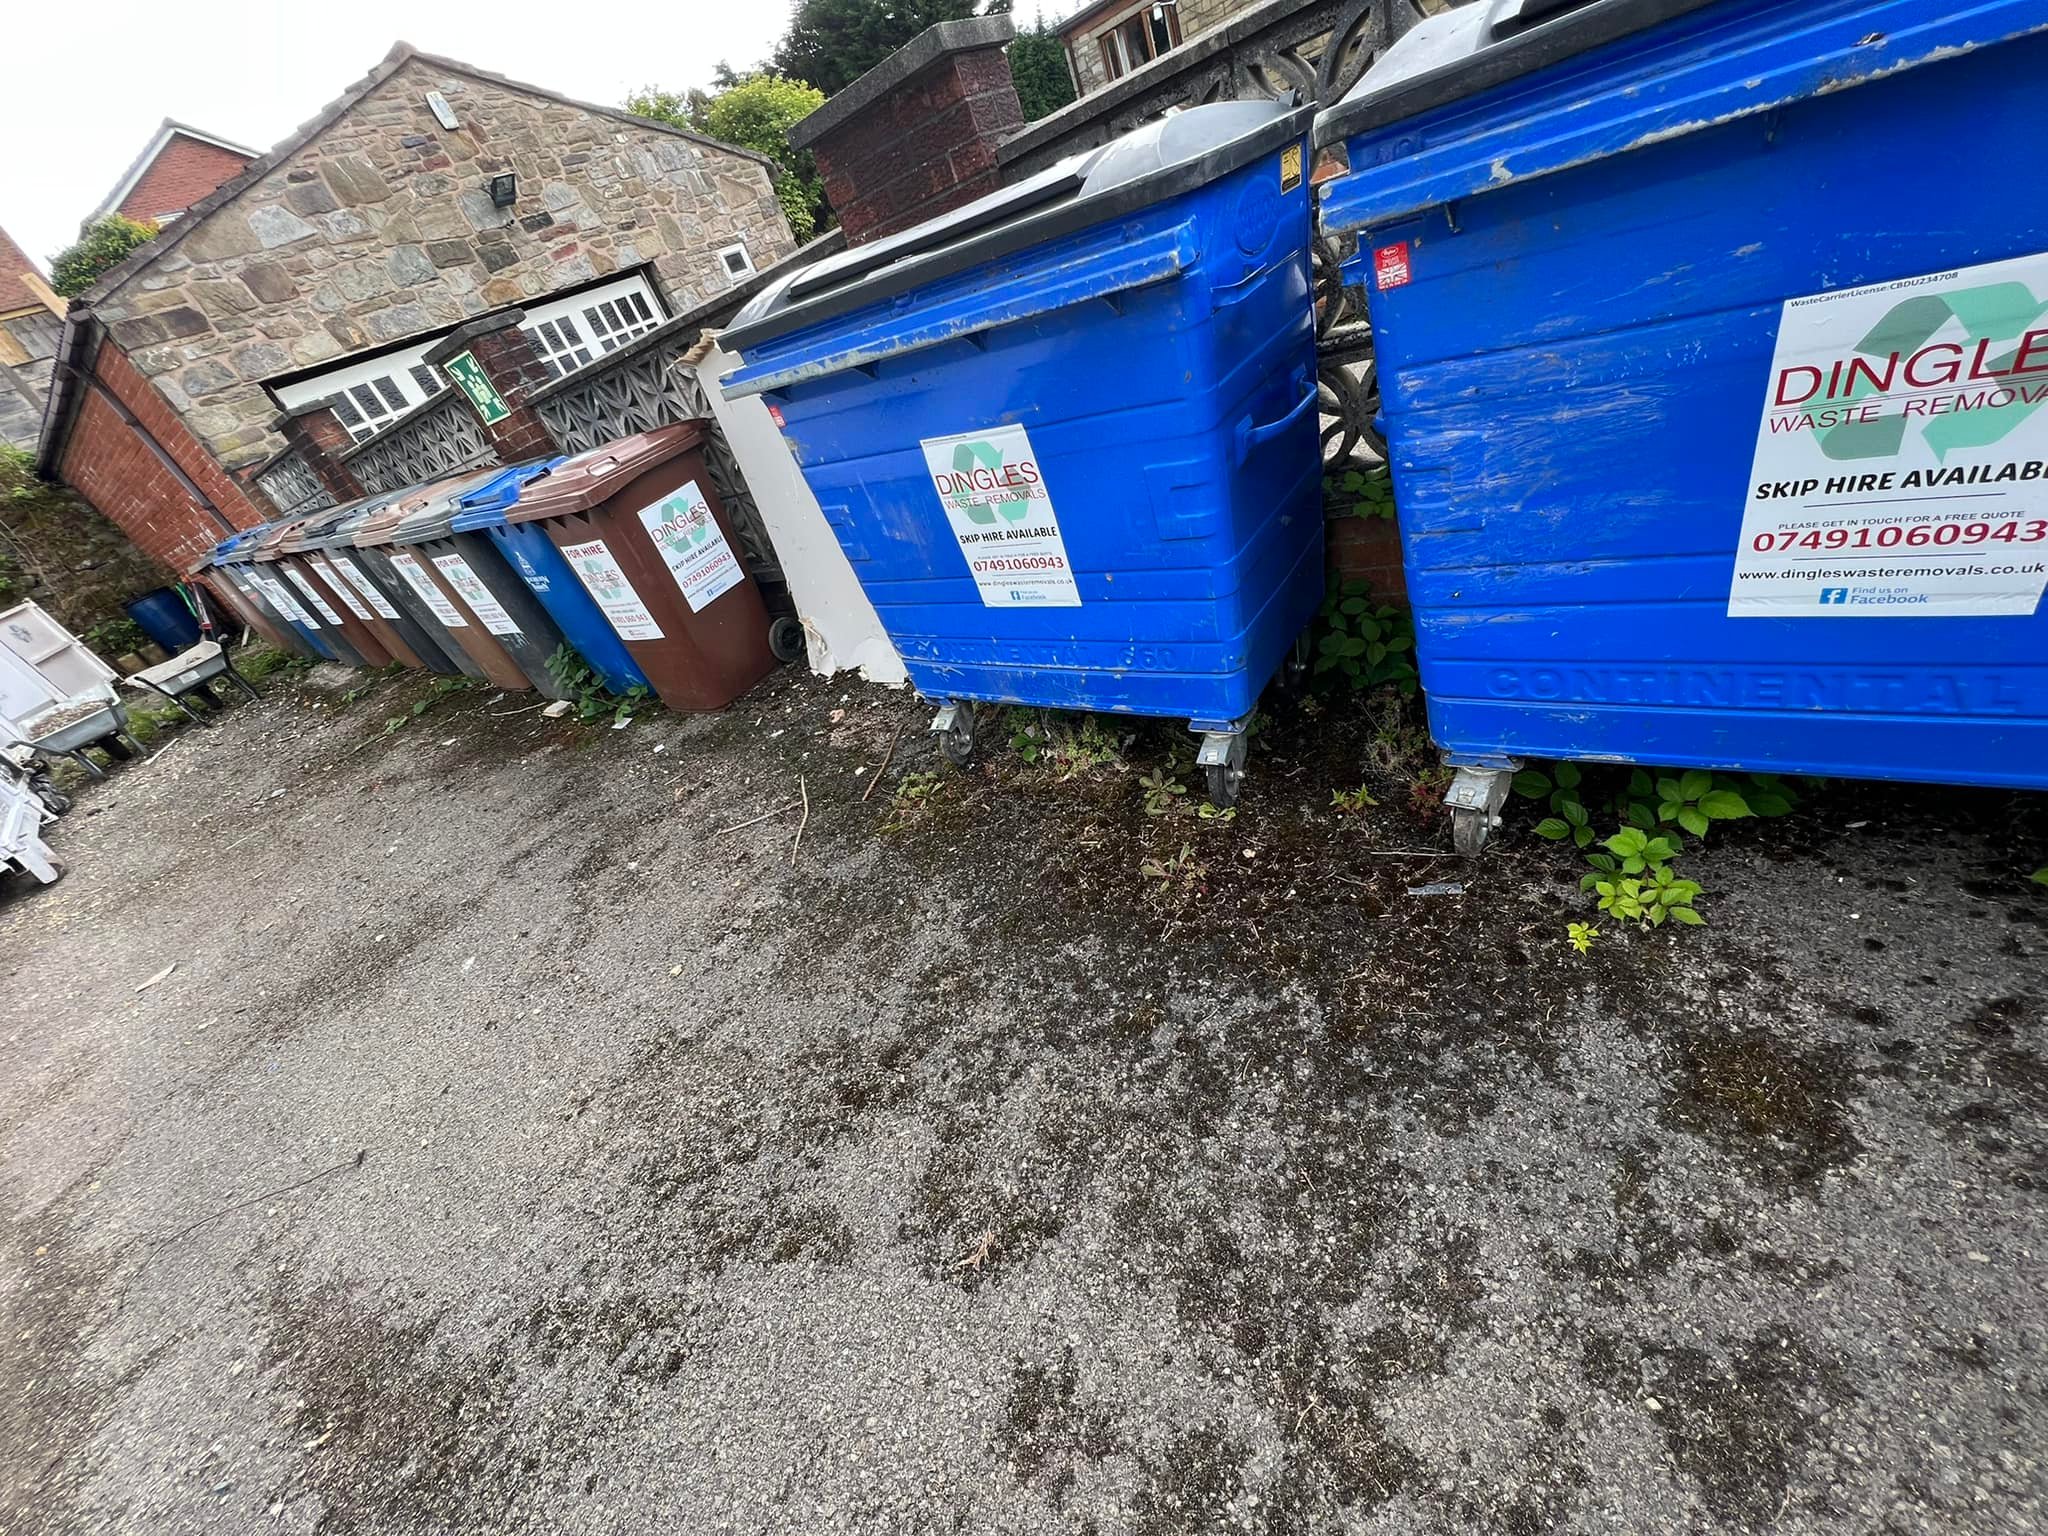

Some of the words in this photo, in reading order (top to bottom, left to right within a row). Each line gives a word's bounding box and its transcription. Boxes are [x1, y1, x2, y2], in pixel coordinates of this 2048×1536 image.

[1769, 404, 1882, 433] WASTE
[935, 462, 1039, 495] DINGLES
[1755, 479, 1819, 500] SKIP
[1824, 472, 1897, 494] HIRE
[1900, 460, 2048, 489] AVAILAB
[944, 497, 983, 510] WASTE
[984, 488, 1047, 506] REMOVALS
[651, 501, 709, 543] DINGLES
[1778, 521, 1819, 530] PLEASE
[1822, 519, 1844, 528] GET
[1846, 519, 1859, 527] IN
[1861, 516, 1902, 526] TOUCH
[1904, 514, 1929, 523] FOR
[1931, 513, 1942, 522] A
[1944, 512, 1978, 521] FREE
[1980, 510, 2026, 520] QUOTE
[959, 533, 981, 544] SKIP
[981, 530, 1006, 542] HIRE
[1006, 526, 1058, 540] AVAILABLE
[1752, 519, 2048, 552] 07491060943
[565, 549, 583, 560] FOR
[582, 543, 605, 557] HIRE
[973, 556, 1065, 572] 07491060943
[1739, 562, 2045, 581] www.dingleswasteremovals.co.uk
[1850, 593, 1928, 605] Facebook
[1852, 586, 1875, 594] Find
[1485, 667, 2024, 713] CONTINENTAL
